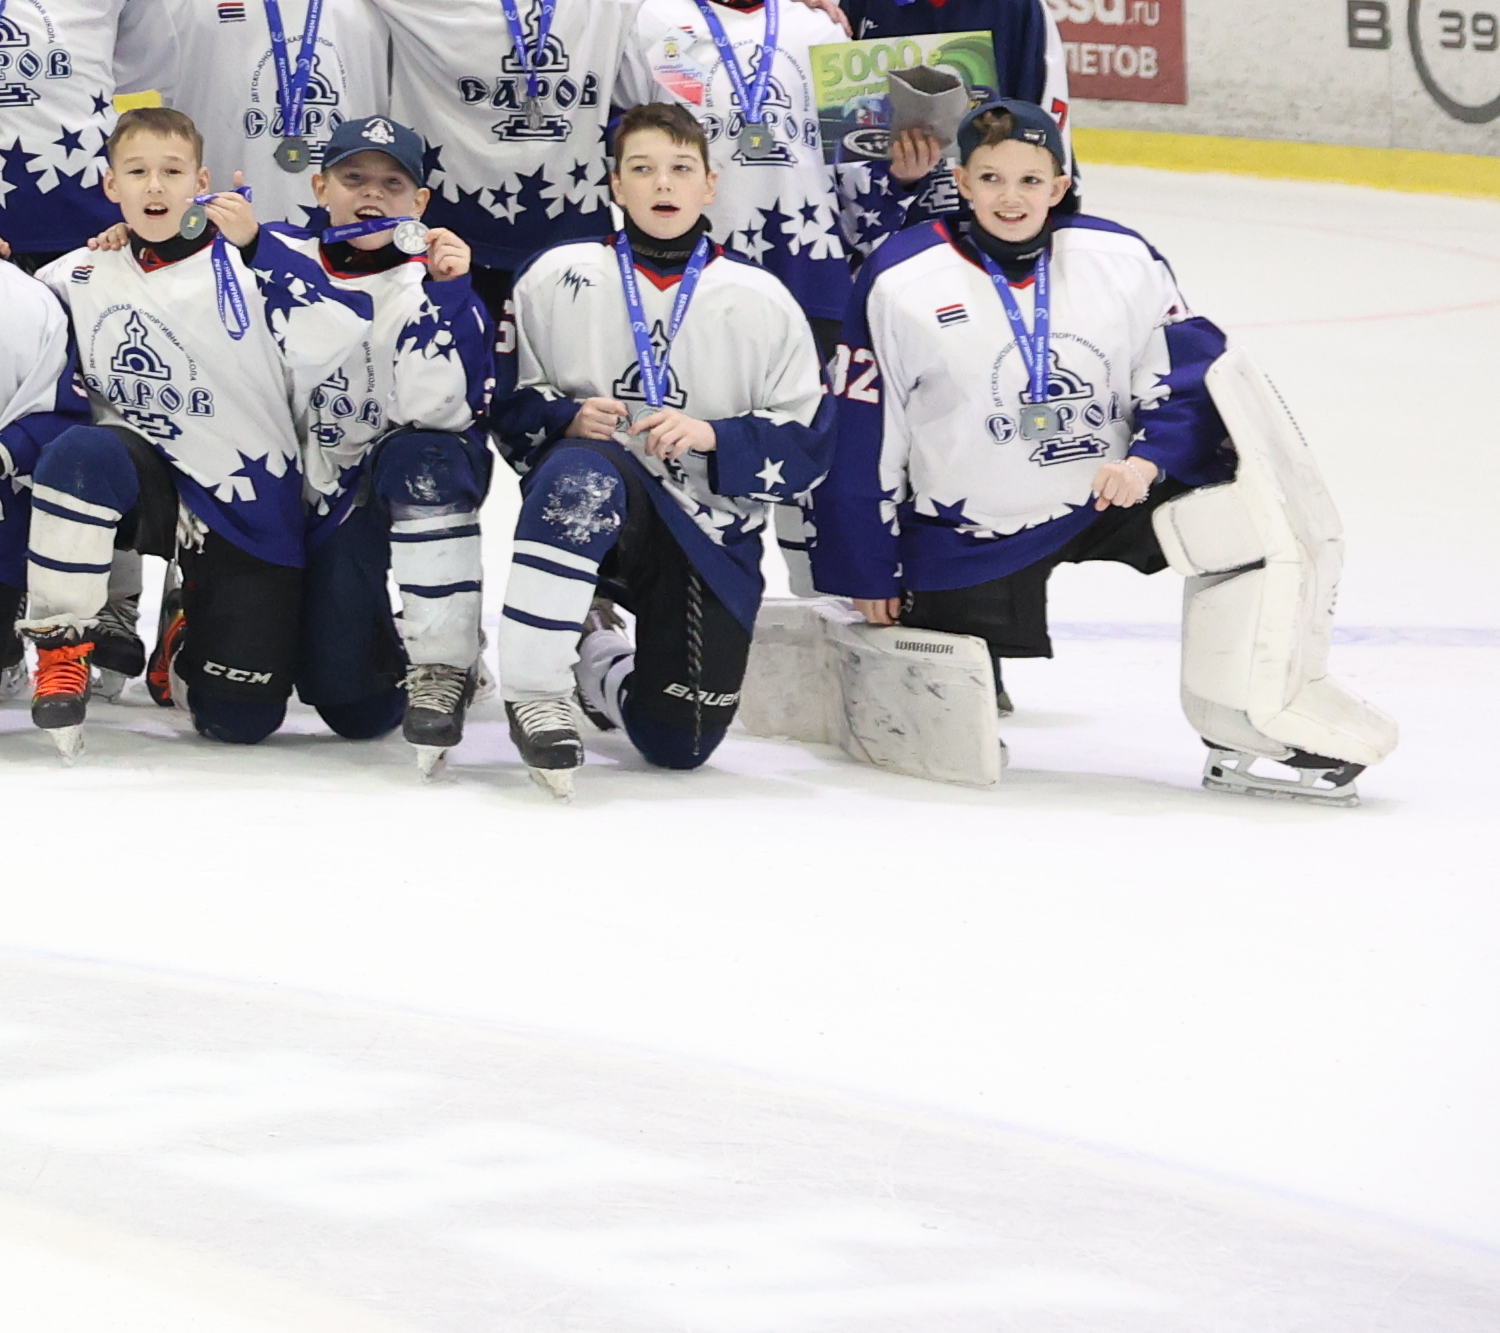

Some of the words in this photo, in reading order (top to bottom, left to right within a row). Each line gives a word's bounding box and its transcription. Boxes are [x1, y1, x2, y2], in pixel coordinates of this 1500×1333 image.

[1064, 41, 1158, 79] ЛЕТОВ
[458, 71, 600, 115] САРОВ
[1050, 332, 1106, 360] ПОРТИВНАЯ
[895, 639, 955, 655] WARRIOR
[204, 660, 274, 685] CCM
